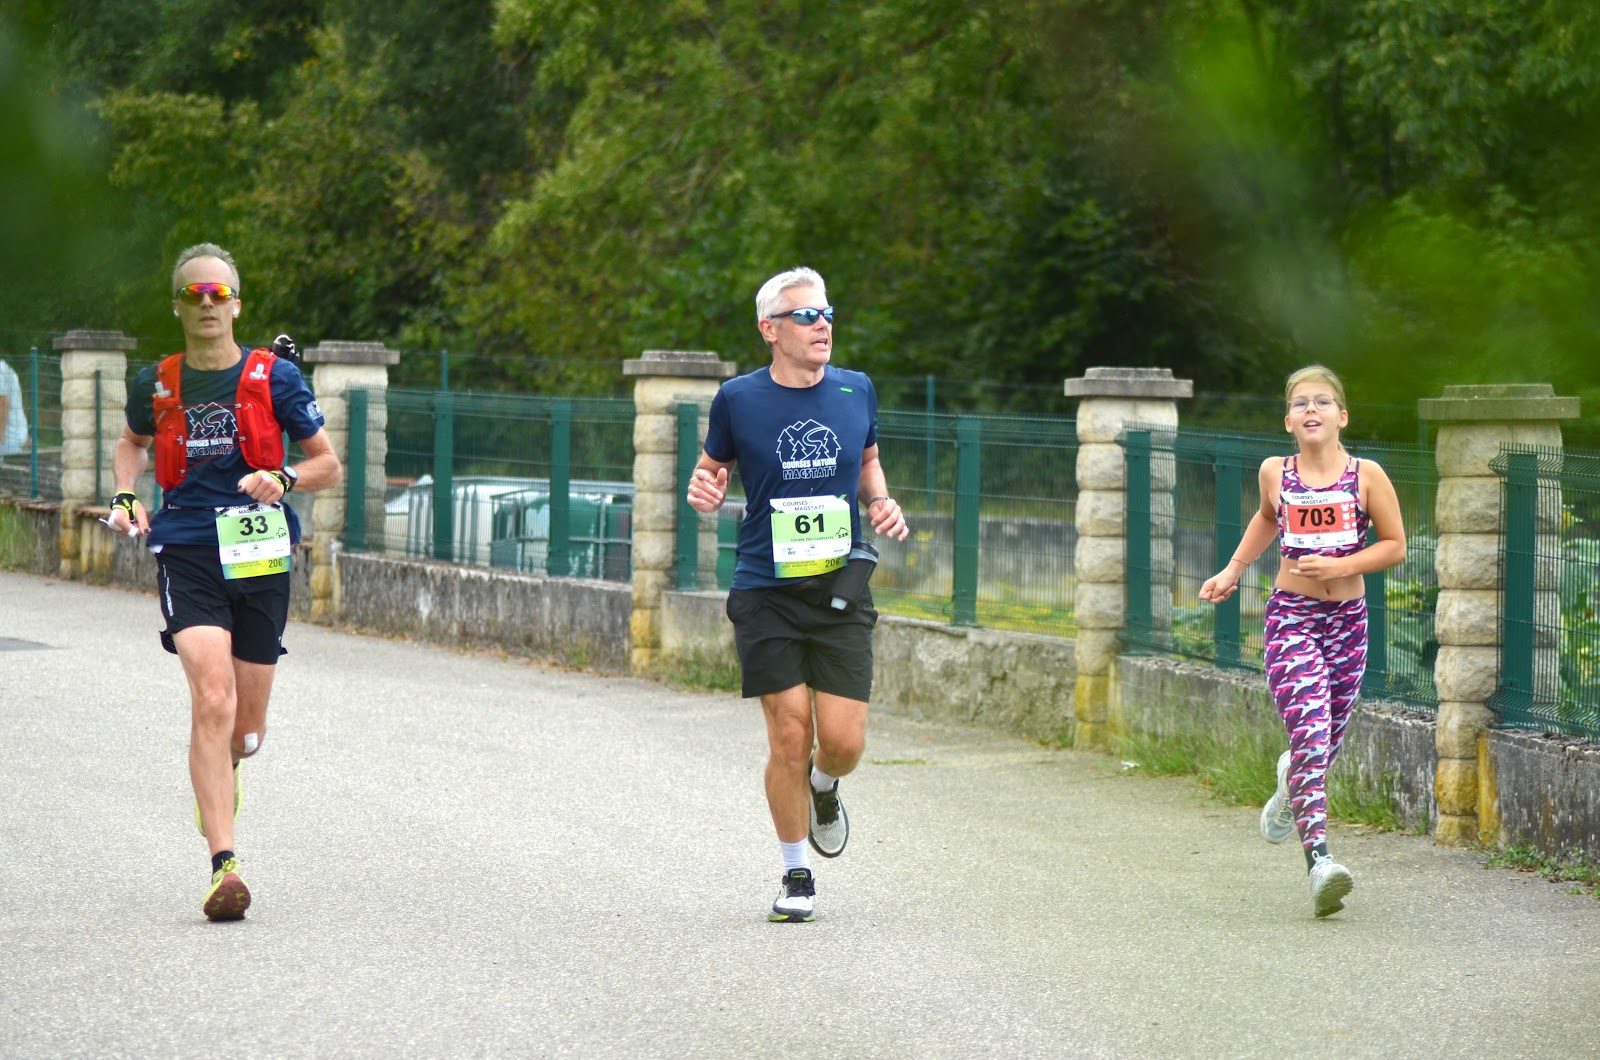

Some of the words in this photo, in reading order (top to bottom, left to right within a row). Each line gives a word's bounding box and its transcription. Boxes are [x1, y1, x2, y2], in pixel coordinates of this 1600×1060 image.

[186, 439, 209, 448] OURSES
[210, 437, 234, 446] NATURE
[782, 460, 811, 470] COURSES
[812, 457, 837, 468] NATURE
[783, 466, 837, 480] MAGSTATT
[794, 513, 825, 534] 61
[1297, 506, 1336, 528] 703
[239, 515, 269, 536] 33
[268, 558, 283, 569] 20€
